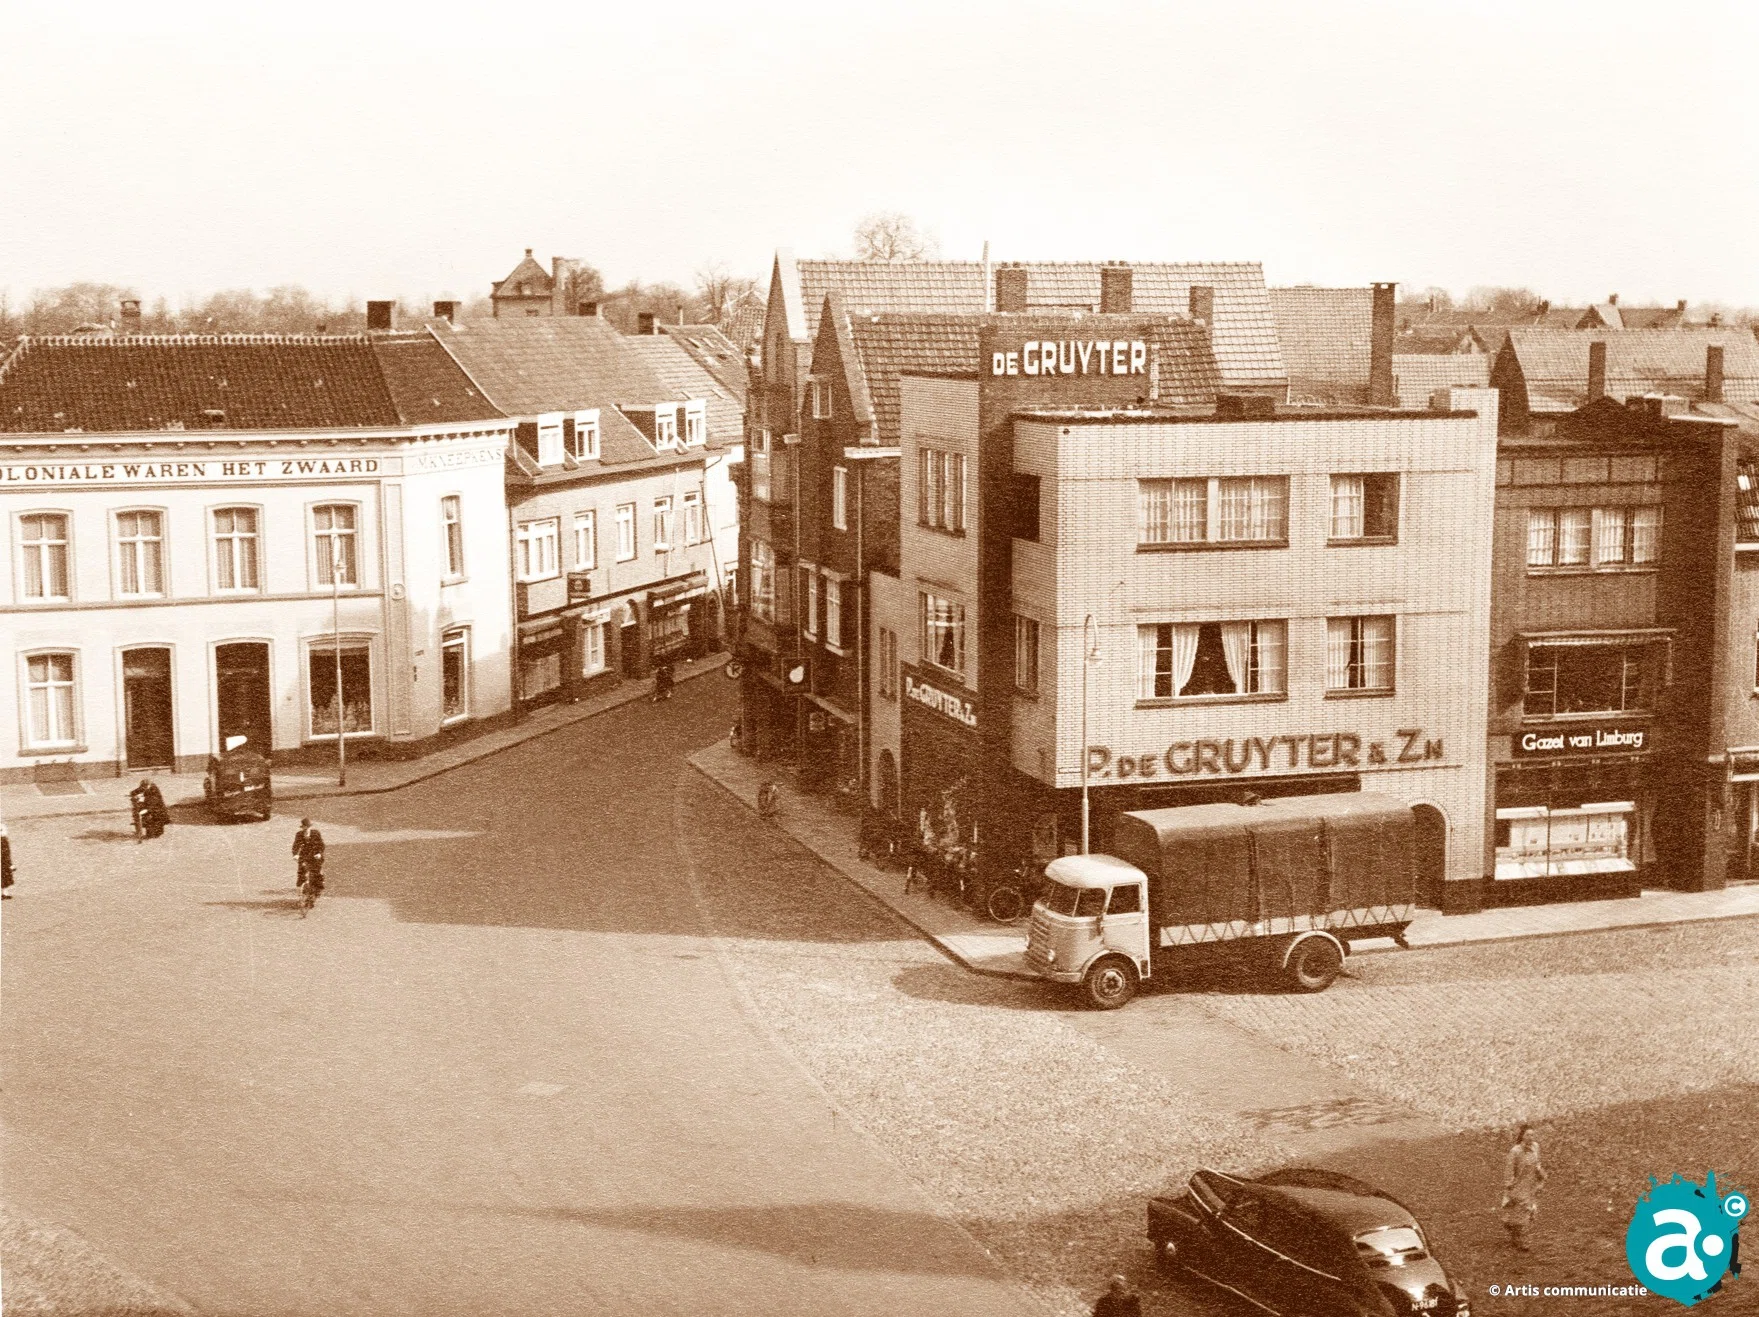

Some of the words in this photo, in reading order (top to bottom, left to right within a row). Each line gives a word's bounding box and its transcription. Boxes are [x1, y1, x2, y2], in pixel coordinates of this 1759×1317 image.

[992, 351, 1019, 376] DE
[1023, 340, 1147, 375] GRUYTER
[123, 462, 207, 479] WAREN
[222, 461, 266, 477] HET
[281, 458, 379, 475] ZWAARD
[1569, 735, 1592, 748] van
[1596, 729, 1643, 748] Limburg
[1116, 753, 1158, 779] DE
[1163, 731, 1361, 775] GRUYTER
[1366, 740, 1388, 766] &
